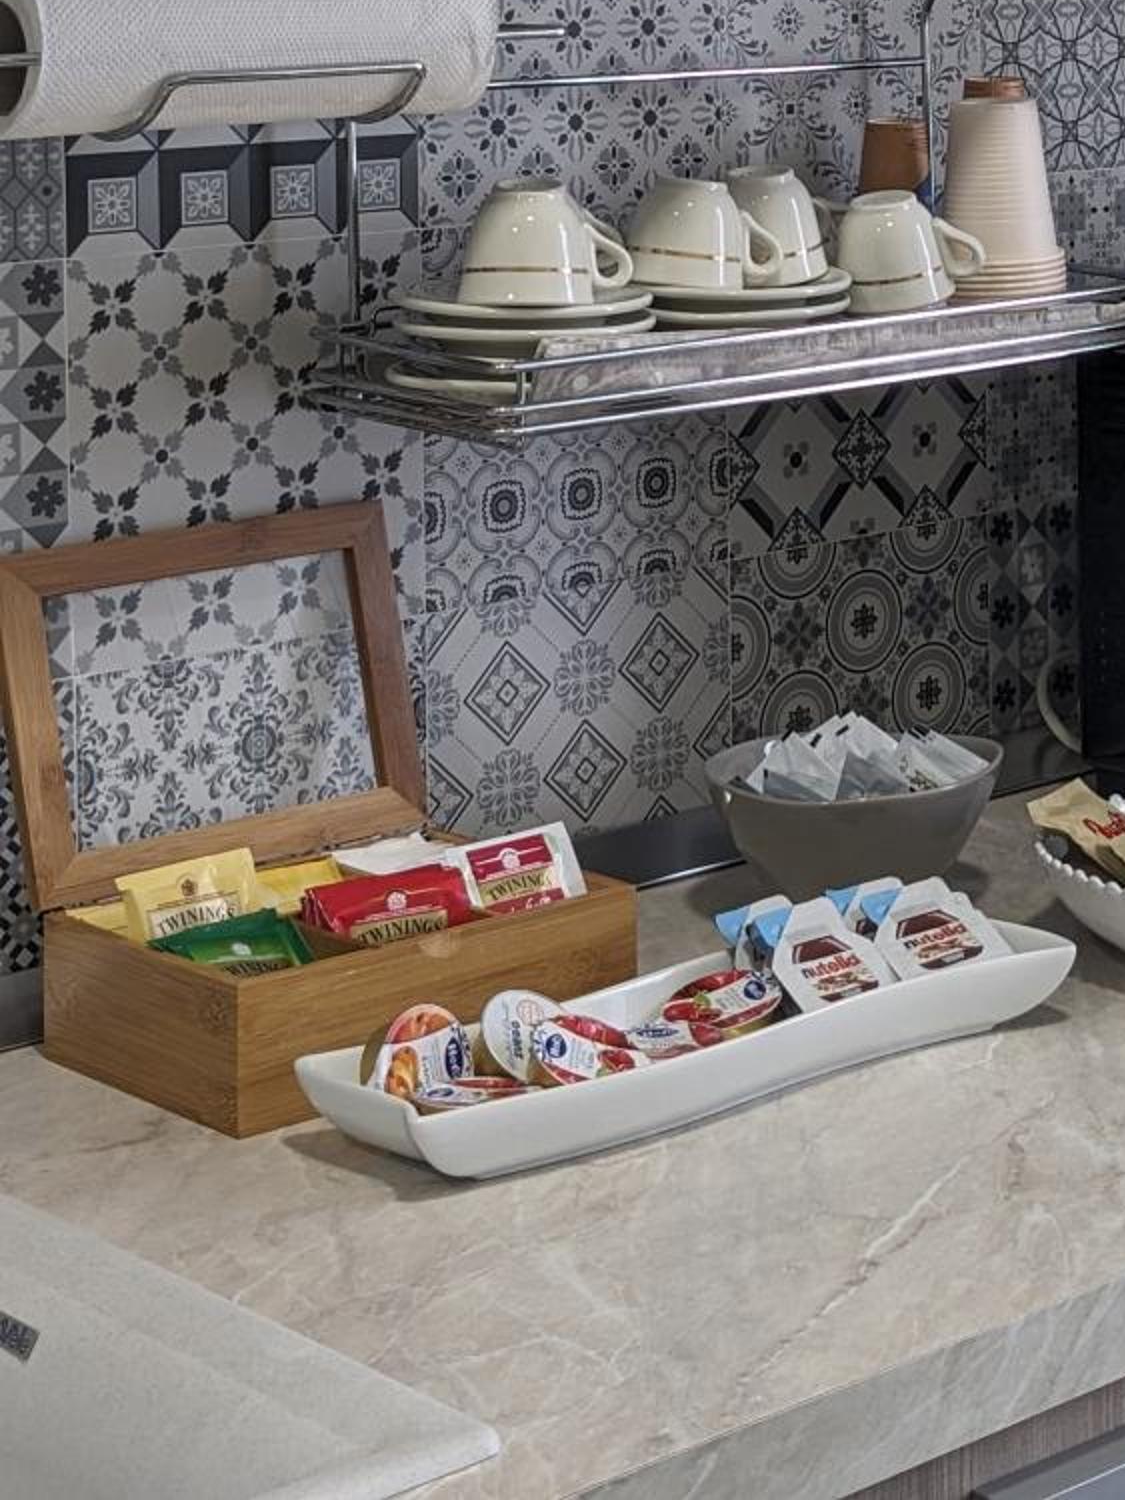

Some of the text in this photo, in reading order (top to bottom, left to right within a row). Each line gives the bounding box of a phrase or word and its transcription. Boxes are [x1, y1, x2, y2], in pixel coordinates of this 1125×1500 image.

[357, 915, 445, 943] TWININGS
[903, 922, 967, 949] nutella
[801, 953, 862, 979] nutella
